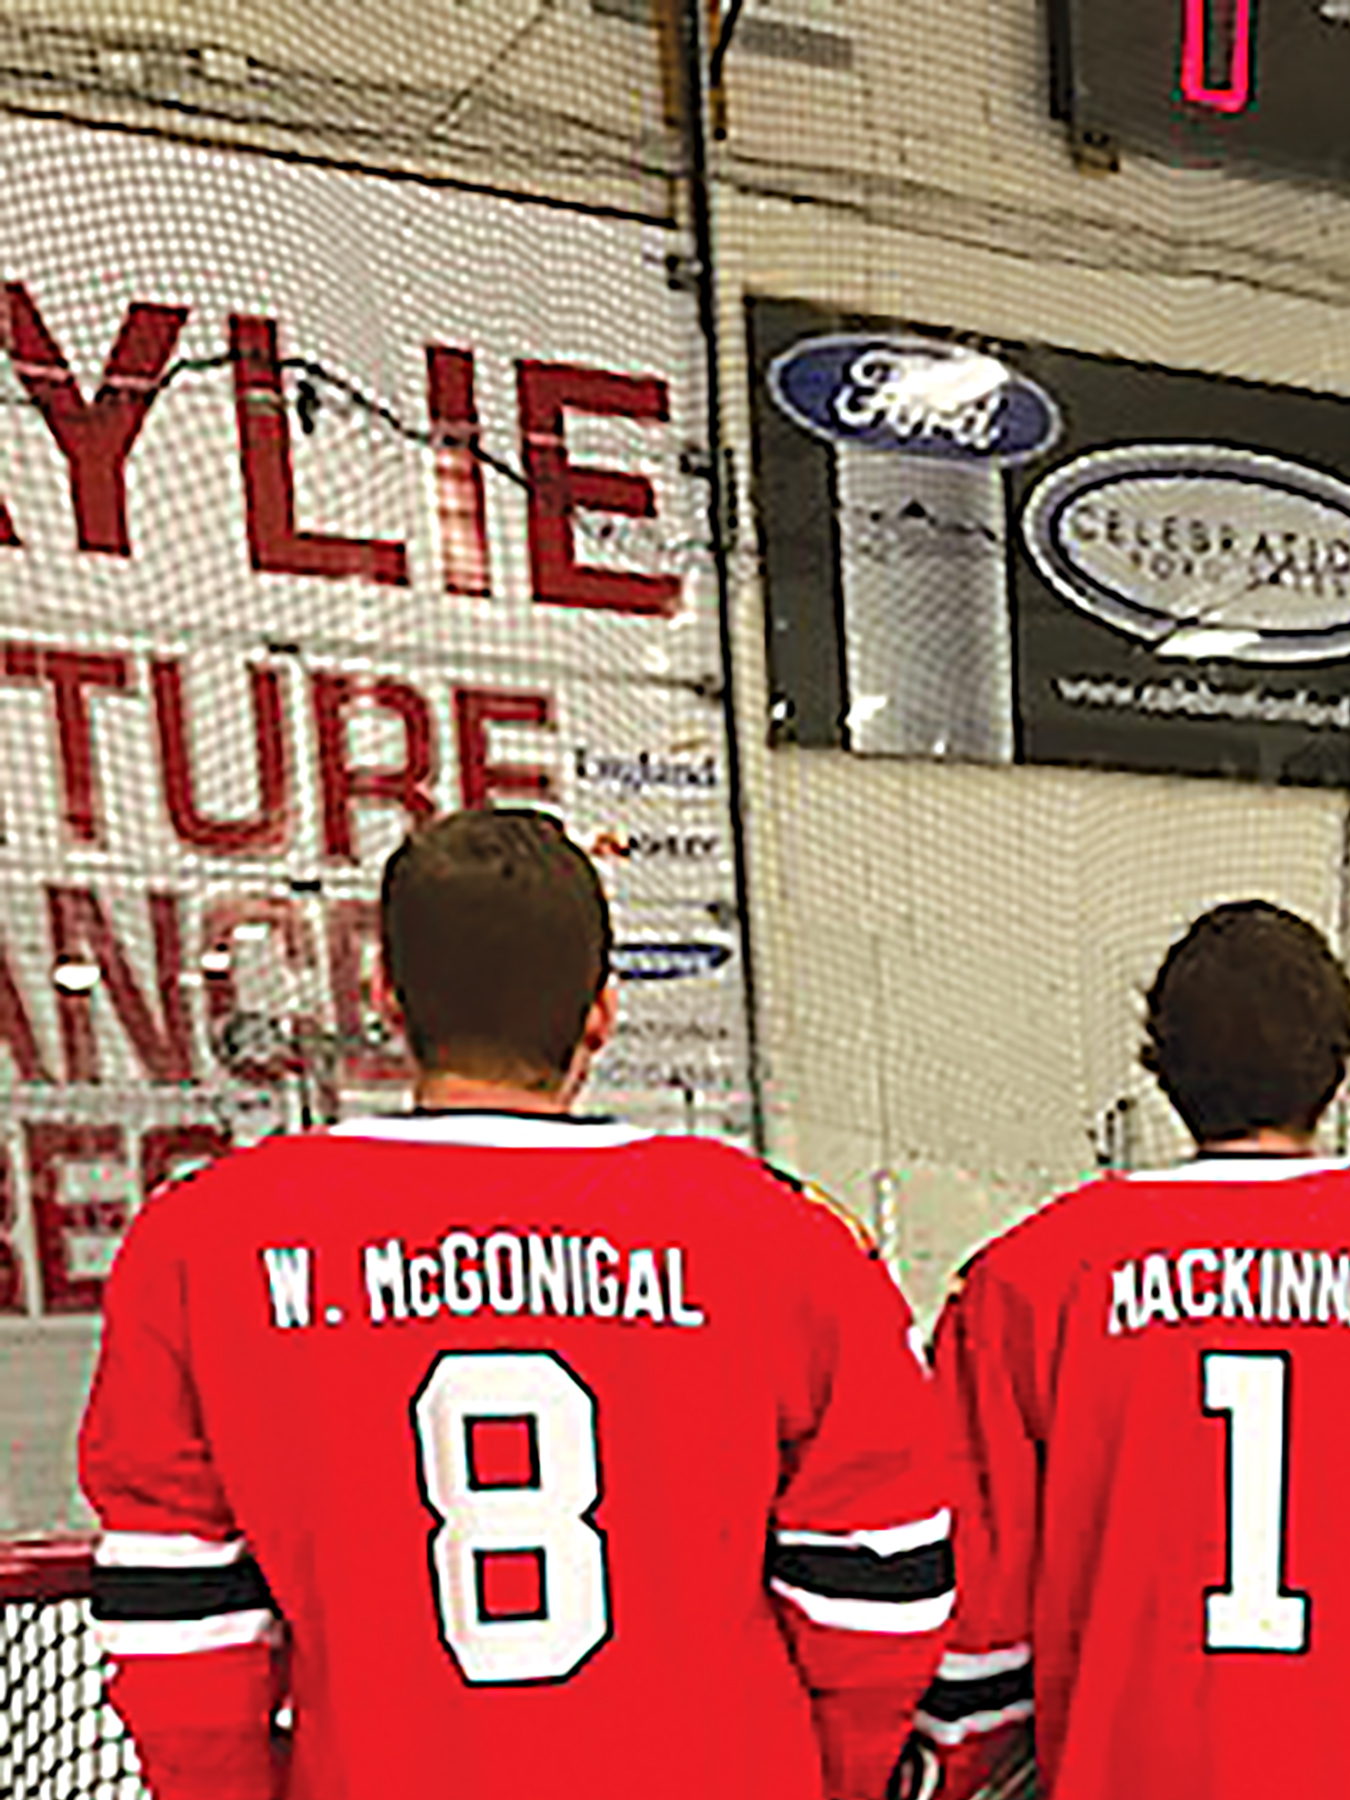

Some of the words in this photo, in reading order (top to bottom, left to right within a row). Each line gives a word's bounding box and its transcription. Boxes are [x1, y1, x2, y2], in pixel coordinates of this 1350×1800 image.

[0, 282, 684, 618] YLIE
[834, 350, 1008, 450] Ford
[0, 641, 560, 866] TURE
[263, 1244, 345, 1330] W.
[362, 1230, 707, 1329] McGONIGAL
[409, 1348, 615, 1688] 8
[1202, 1350, 1311, 1654] 1
